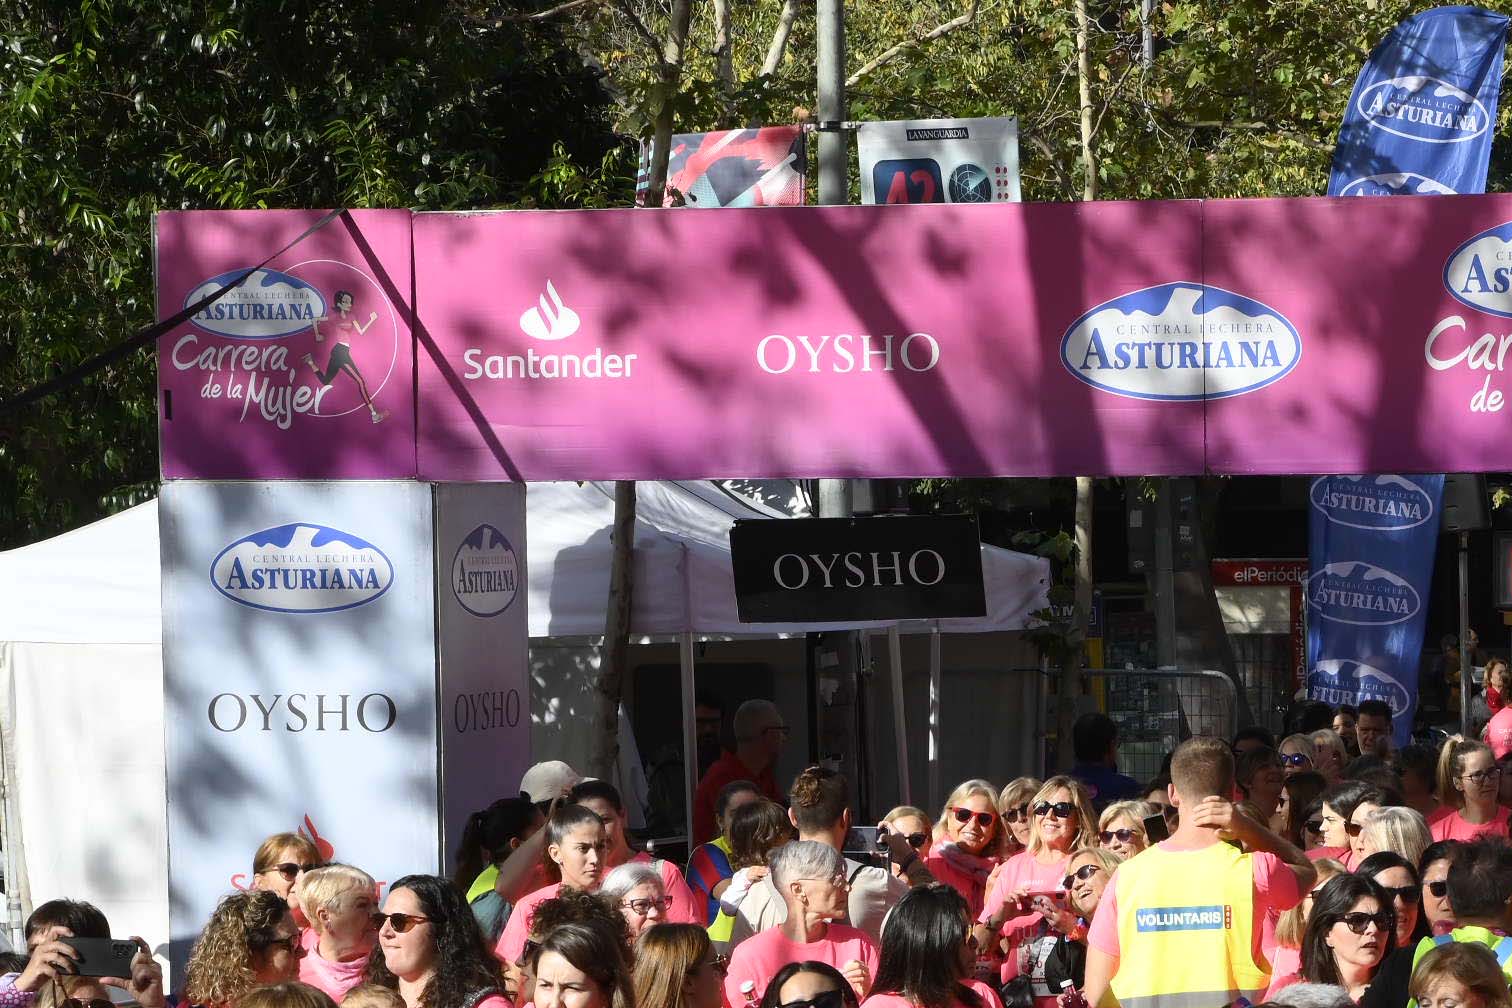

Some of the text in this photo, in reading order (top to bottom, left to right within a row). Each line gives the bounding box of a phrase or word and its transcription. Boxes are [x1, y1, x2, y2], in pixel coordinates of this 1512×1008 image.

[1367, 92, 1477, 132] ASTURIANA
[198, 294, 314, 321] ASTURIANA
[220, 291, 259, 299] ENTRAL
[1116, 323, 1274, 335] CENTRAL LECHERA
[172, 334, 288, 371] Carrera
[463, 347, 638, 380] Santander
[756, 333, 941, 374] OYSHO
[1080, 327, 1282, 370] ASTURIANA
[201, 368, 333, 430] de la Mujer
[1469, 374, 1504, 412] de
[1320, 483, 1423, 520] ASTURIANA
[225, 556, 381, 591] ASTURIANA
[253, 554, 375, 564] CENTRAL LECHERA
[457, 558, 515, 595] ASTURIANA
[773, 549, 945, 589] OYSHO
[1313, 578, 1410, 614] ASTURIANA
[208, 692, 397, 733] OYSHO
[455, 688, 520, 733] OYSHO
[1138, 910, 1222, 927] VOLUNTARIS
